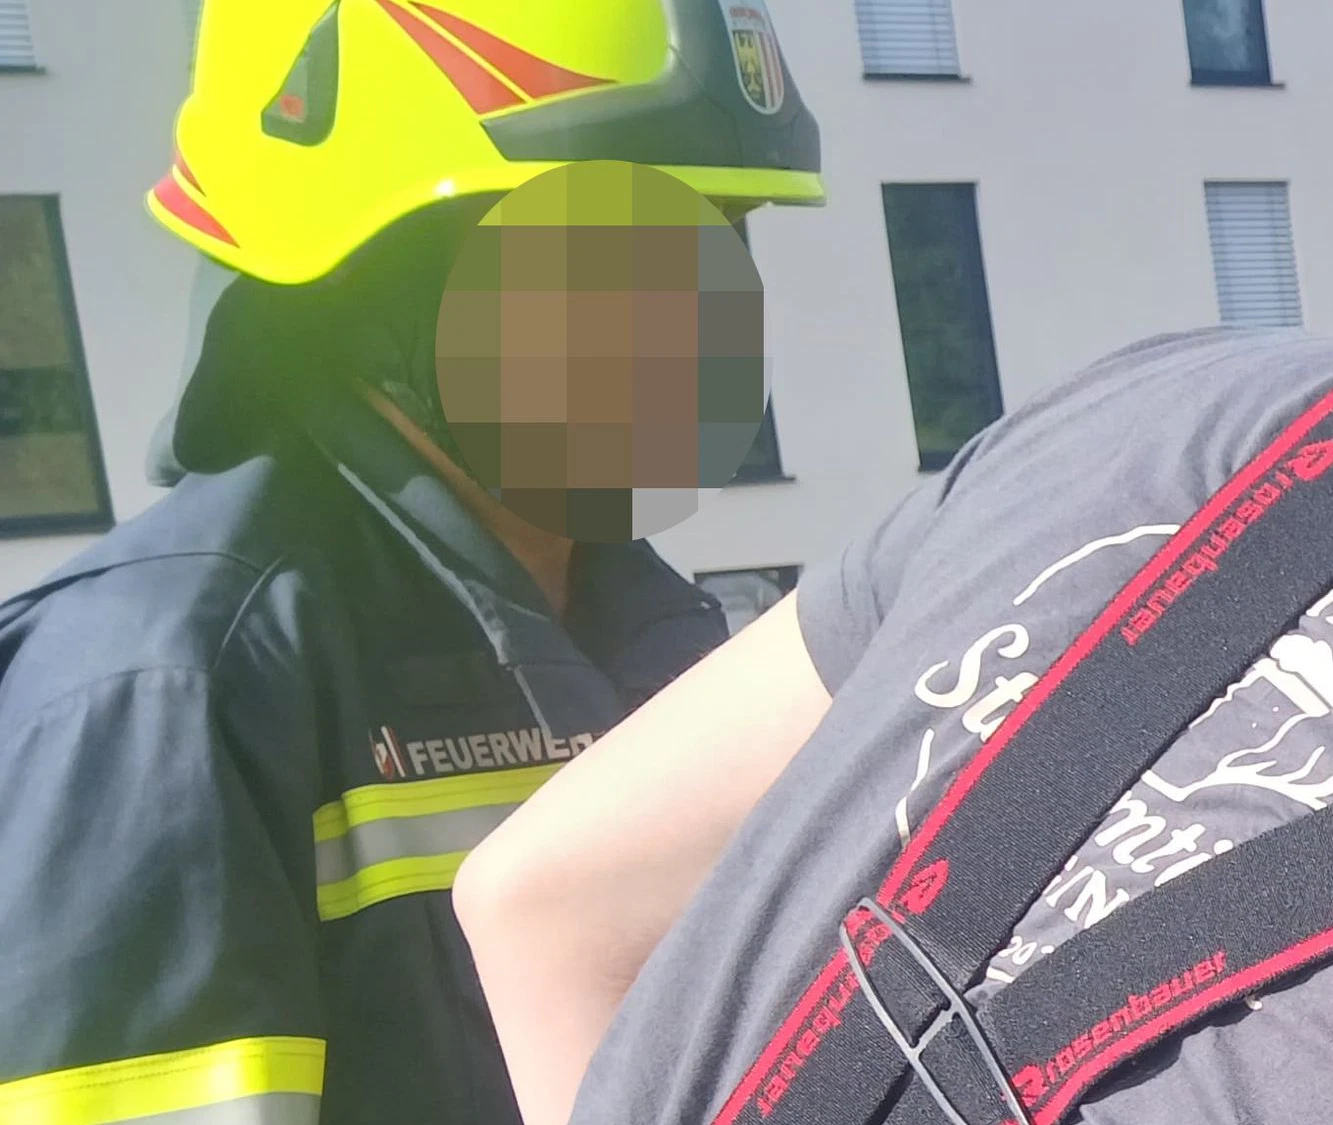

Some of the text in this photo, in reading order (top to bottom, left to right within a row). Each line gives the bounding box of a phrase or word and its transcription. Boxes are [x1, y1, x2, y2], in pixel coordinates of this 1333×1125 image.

[1120, 471, 1294, 647] rosenbauer
[914, 623, 1041, 743] St
[1045, 947, 1227, 1084] rosenbauer
